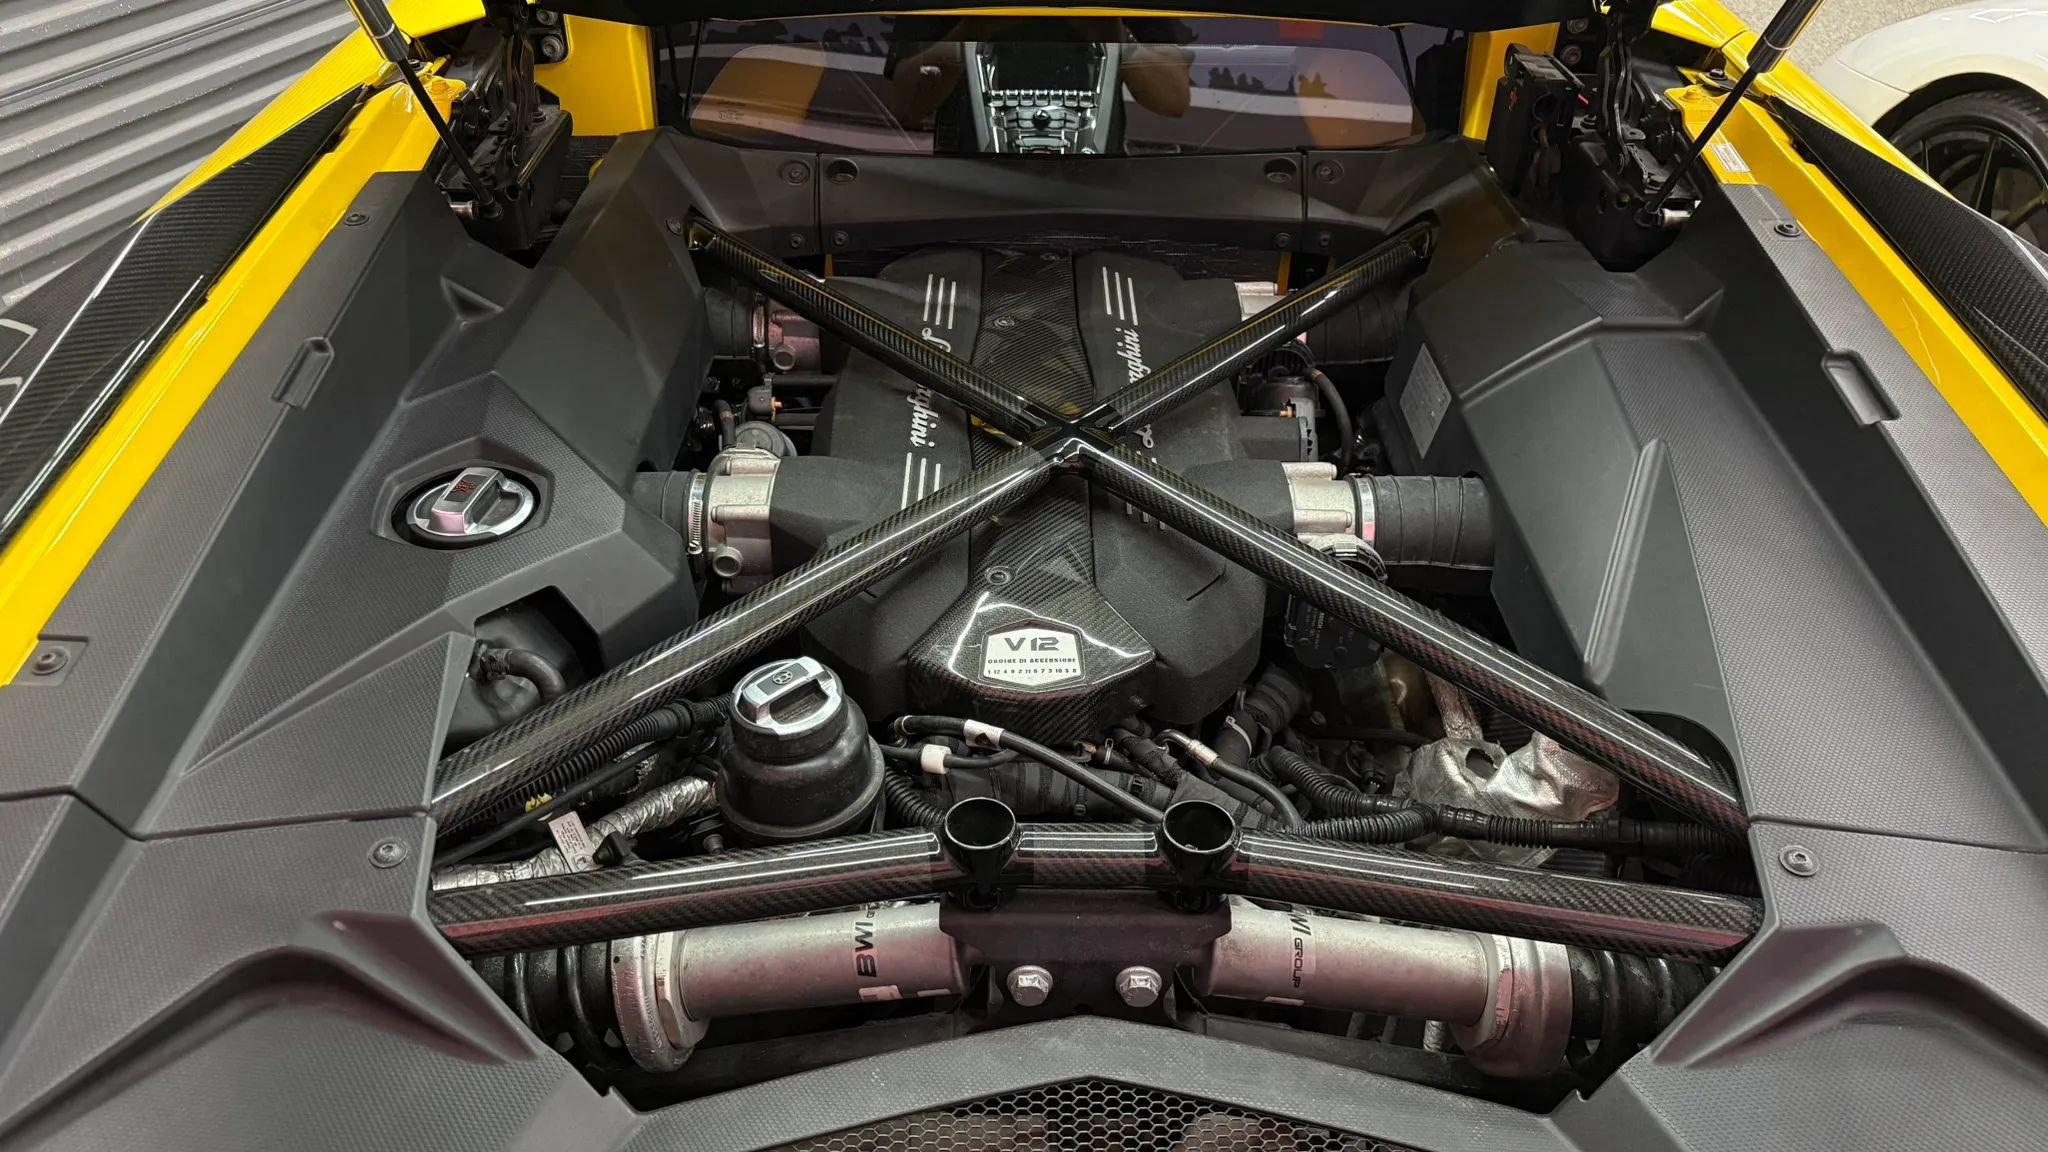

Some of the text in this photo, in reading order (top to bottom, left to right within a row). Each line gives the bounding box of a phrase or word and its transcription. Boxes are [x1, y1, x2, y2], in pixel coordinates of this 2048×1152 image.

[1004, 637, 1059, 651] V12
[855, 922, 877, 977] BWI
[1293, 938, 1303, 988] GROUP
